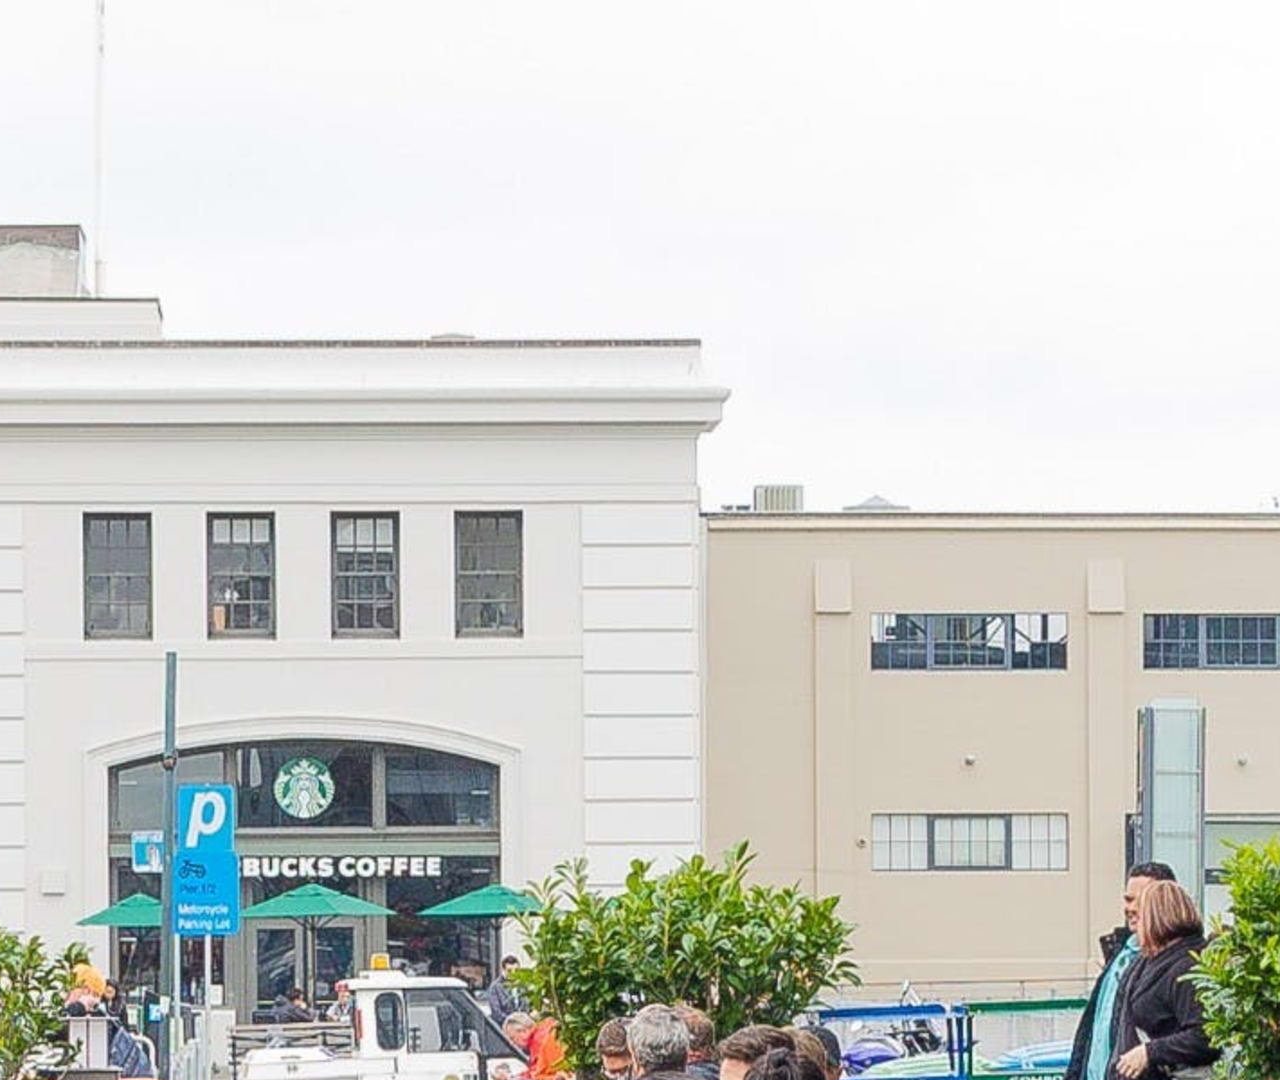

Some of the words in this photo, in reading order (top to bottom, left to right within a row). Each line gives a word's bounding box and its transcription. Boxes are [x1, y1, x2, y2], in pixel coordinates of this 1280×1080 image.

[185, 791, 227, 848] P
[241, 856, 335, 877] BUCKS
[338, 857, 442, 878] COFFEE
[178, 903, 230, 917] Motorcycle
[178, 918, 213, 932] Parking
[215, 918, 231, 930] Lot
